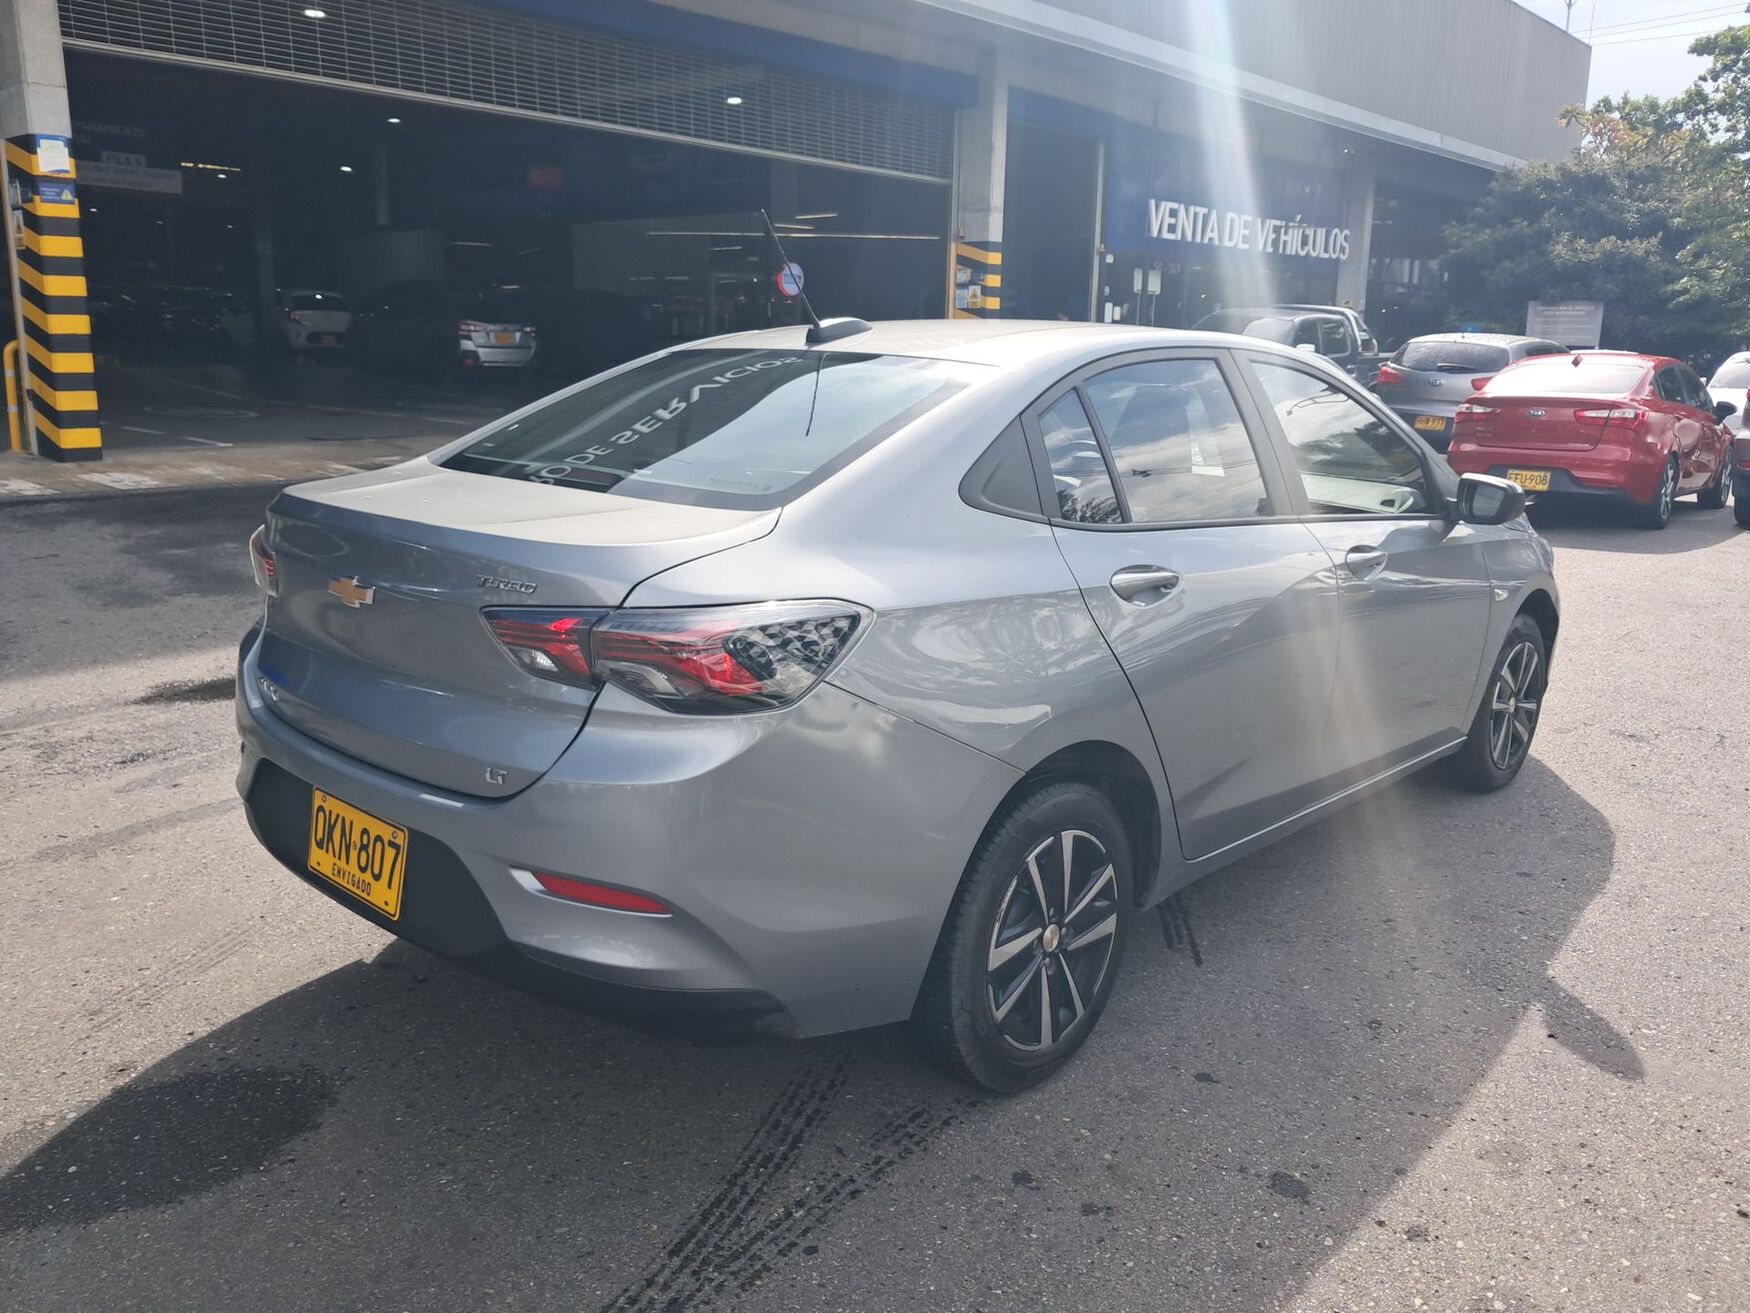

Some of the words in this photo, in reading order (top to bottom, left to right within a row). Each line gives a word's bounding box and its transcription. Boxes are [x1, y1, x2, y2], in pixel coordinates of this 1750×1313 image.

[1148, 198, 1219, 246] VENTA
[1223, 211, 1253, 250] DE
[1256, 213, 1351, 261] VEHÍCULOS
[486, 767, 508, 785] LT
[332, 863, 372, 897] ENVIGADO
